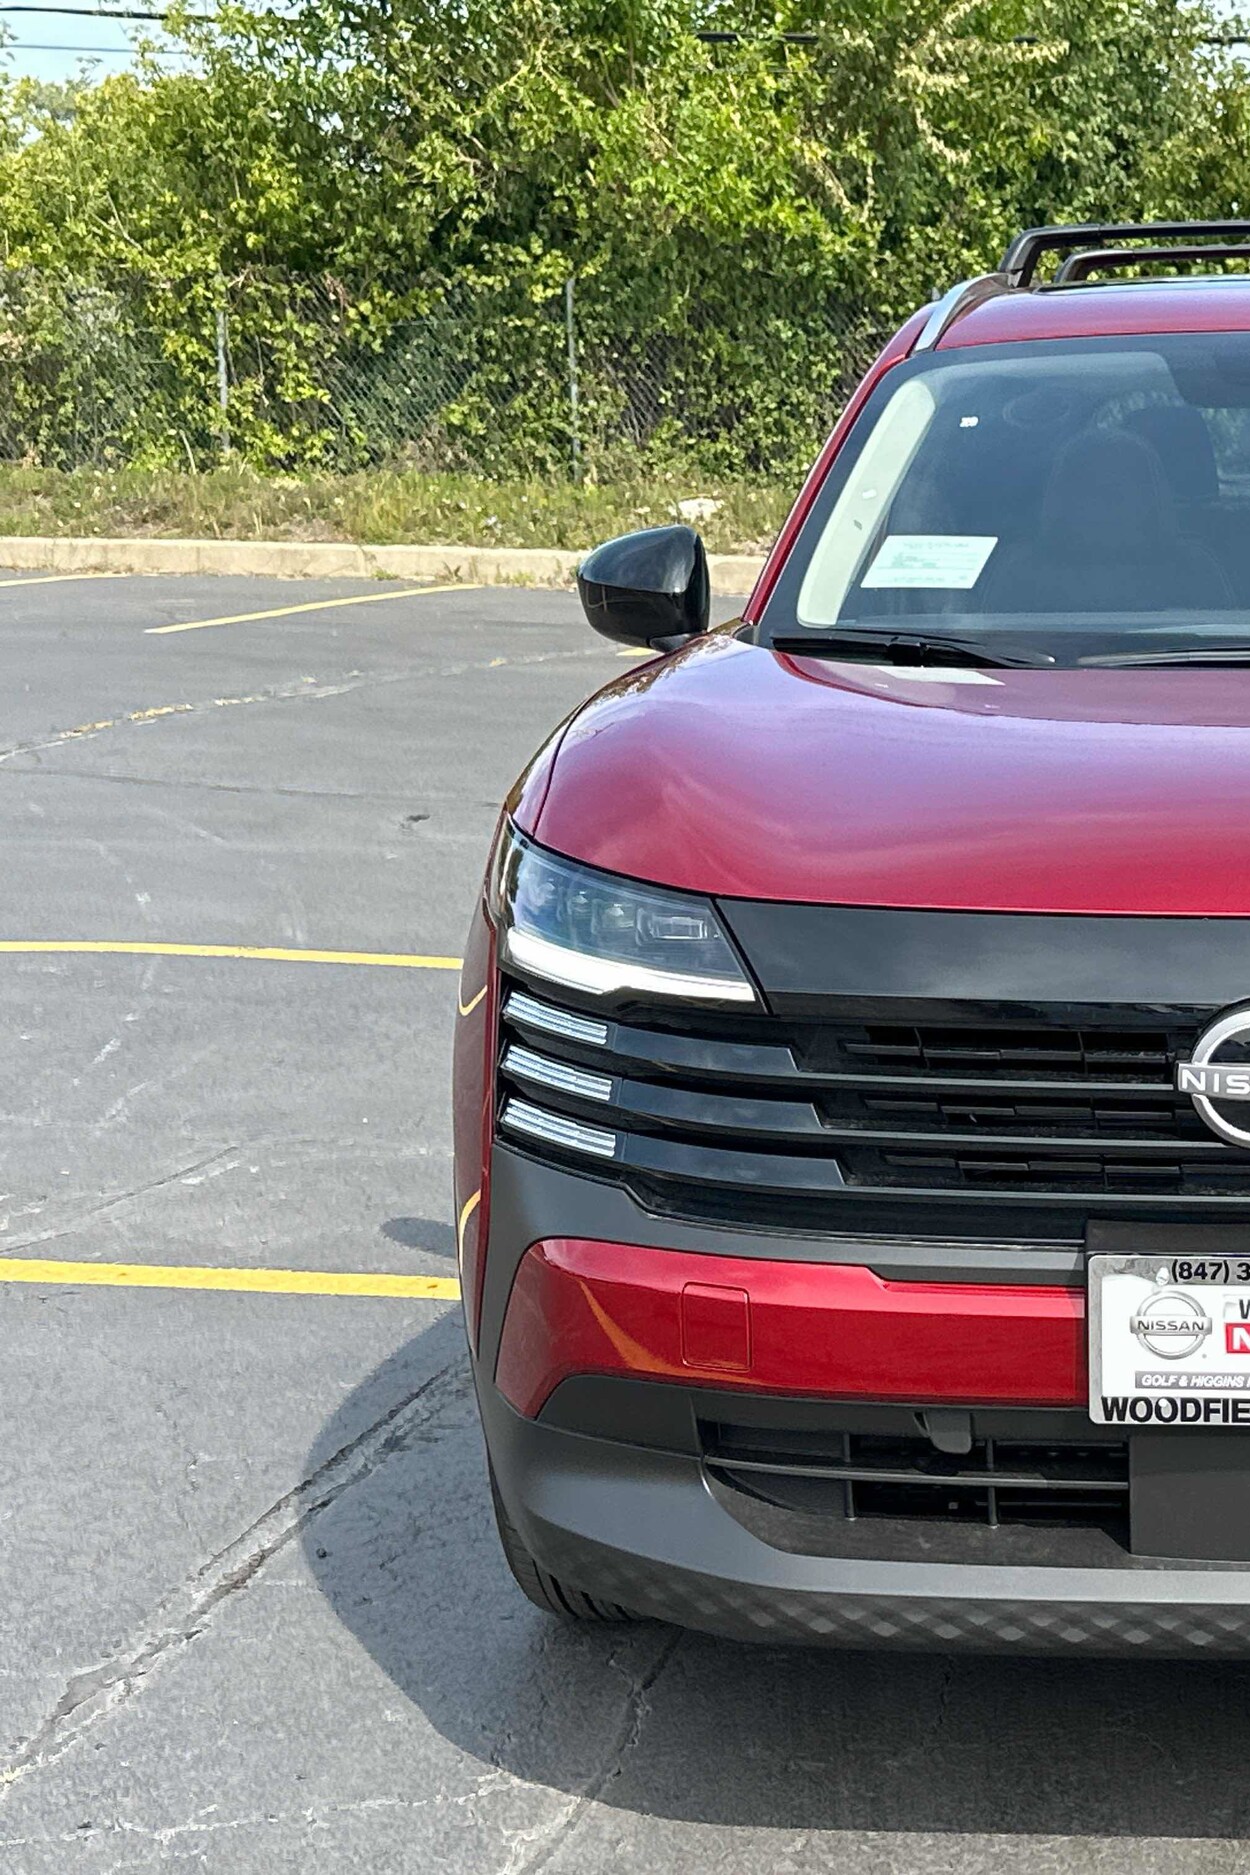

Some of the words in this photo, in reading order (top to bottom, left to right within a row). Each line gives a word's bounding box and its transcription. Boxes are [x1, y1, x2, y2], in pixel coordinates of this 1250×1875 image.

[1171, 1260, 1230, 1283] (847)
[1137, 1319, 1205, 1332] NISSAN
[1141, 1374, 1178, 1387] GOLF
[1178, 1375, 1188, 1387] &
[1190, 1376, 1244, 1388] HIGGINS
